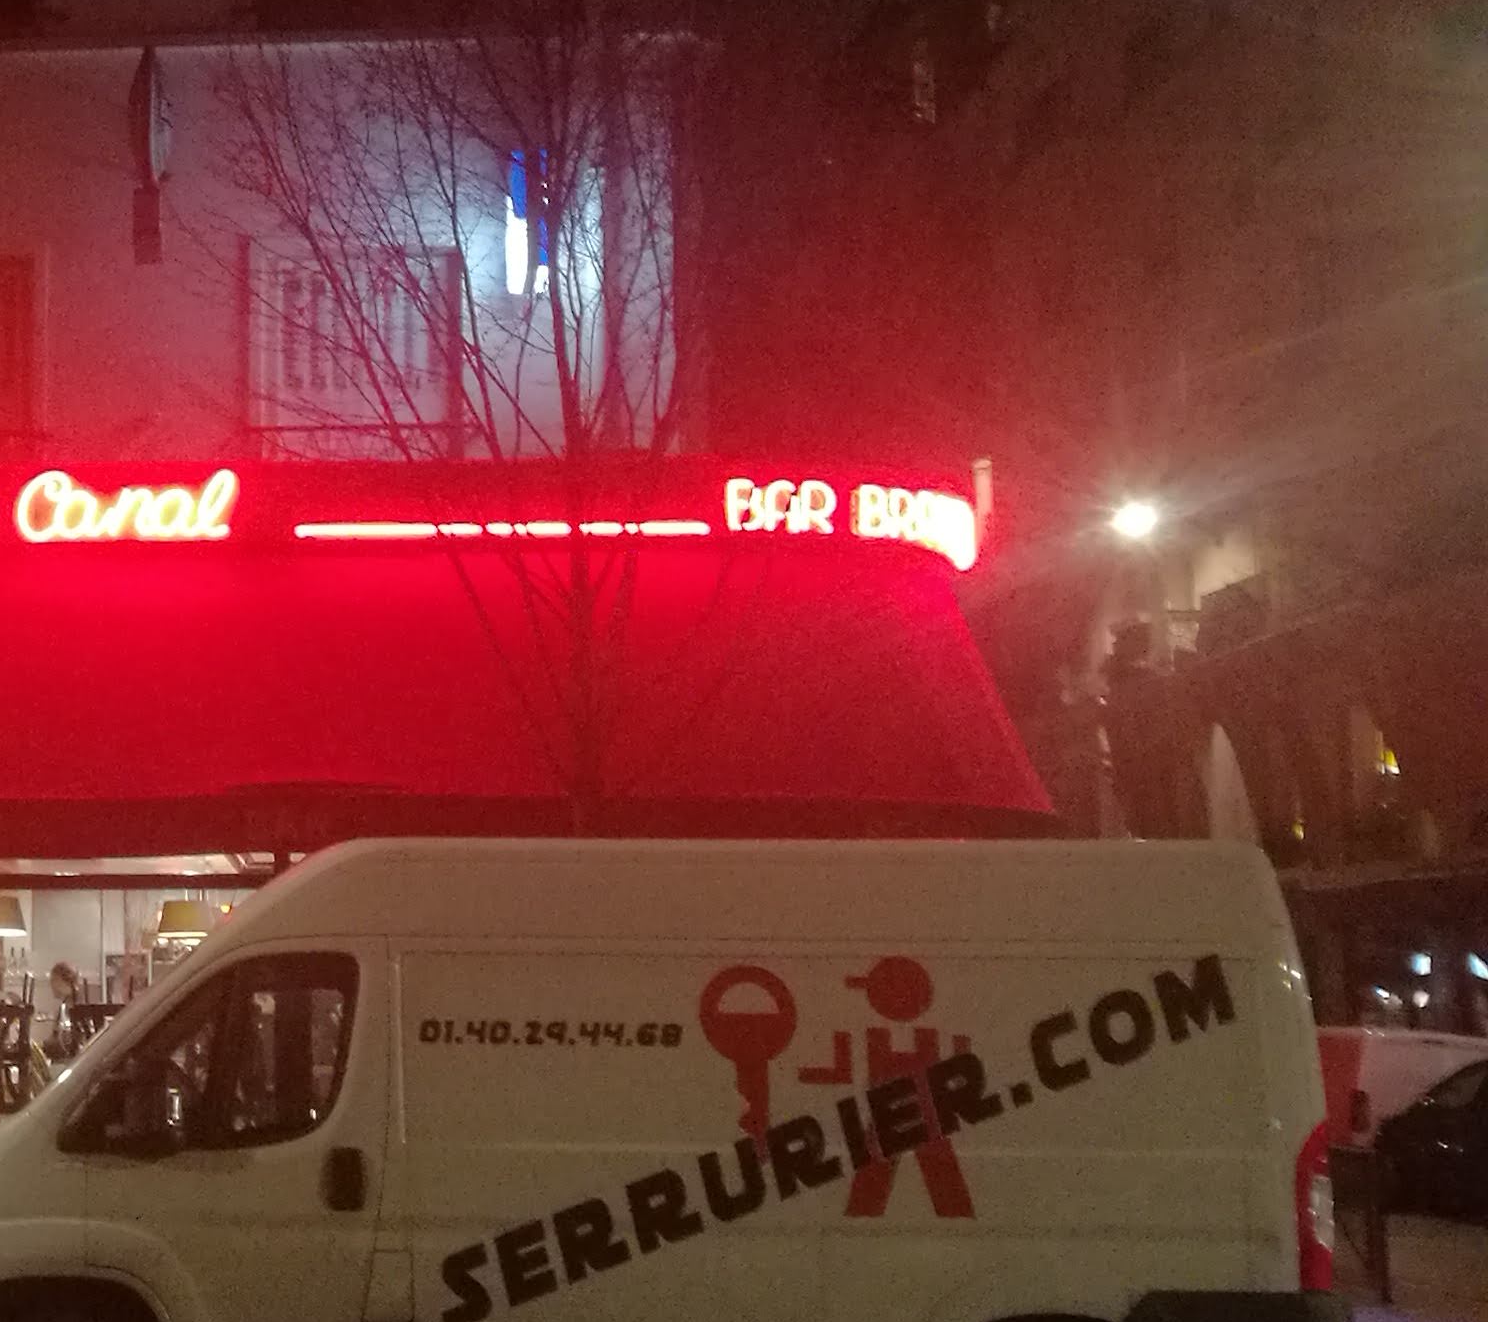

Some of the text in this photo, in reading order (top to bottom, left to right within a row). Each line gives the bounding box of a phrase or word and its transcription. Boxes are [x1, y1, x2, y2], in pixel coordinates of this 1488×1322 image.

[14, 468, 239, 544] Canal
[724, 477, 838, 535] BAR
[418, 1019, 683, 1048] 01.40.29.44.68
